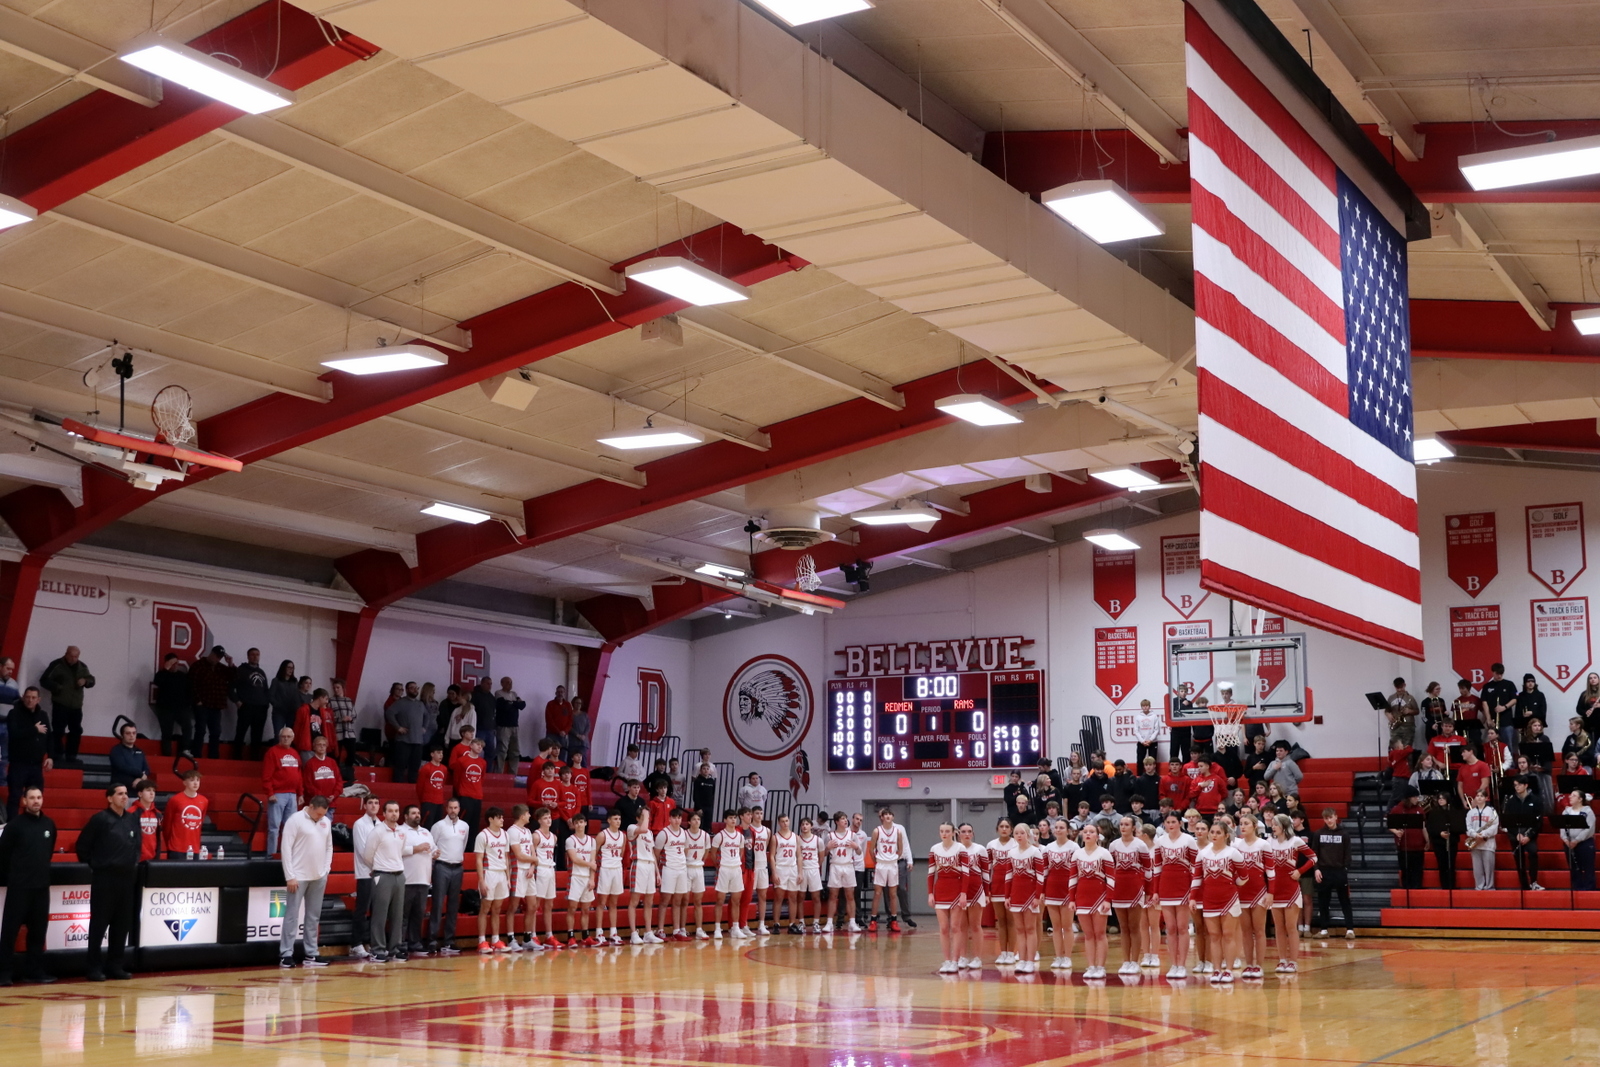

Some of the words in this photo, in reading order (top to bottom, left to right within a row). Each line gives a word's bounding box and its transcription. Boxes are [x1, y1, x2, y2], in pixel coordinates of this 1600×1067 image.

[1467, 576, 1480, 590] B
[1551, 570, 1565, 584] B
[38, 580, 96, 598] ELLEVUE
[1109, 600, 1121, 613] B
[1181, 595, 1192, 608] B
[846, 638, 1022, 678] BELLEVUE
[1471, 669, 1484, 684] B
[1556, 665, 1570, 679] B
[917, 676, 957, 698] 8:00
[1111, 684, 1123, 698] B
[1182, 681, 1195, 695] B
[836, 692, 844, 704] 0
[847, 692, 854, 704] 0
[864, 691, 871, 703] 0
[637, 667, 668, 745] D
[836, 705, 844, 717] 2
[847, 705, 854, 716] 0
[864, 704, 871, 716] 0
[885, 702, 913, 712] REDMEN
[954, 700, 974, 710] RAMS
[847, 718, 854, 730] 0
[864, 717, 871, 729] 0
[896, 714, 907, 734] 0
[931, 716, 936, 730] 1
[973, 711, 984, 732] 0
[833, 731, 844, 743] 10
[847, 731, 854, 743] 0
[864, 730, 871, 742] 0
[994, 726, 1008, 738] 25
[1012, 725, 1020, 738] 0
[1031, 725, 1039, 737] 0
[833, 745, 844, 756] 12
[847, 744, 854, 756] 0
[864, 744, 871, 756] 0
[975, 741, 984, 758] 0
[994, 740, 1009, 752] 31
[1012, 739, 1020, 751] 0
[1031, 738, 1039, 751] 0
[884, 744, 893, 760] 0
[847, 758, 854, 769] 0
[1012, 753, 1020, 765] 0
[993, 774, 1005, 784] EXIT
[755, 842, 764, 851] 30
[883, 845, 892, 853] 34
[1161, 846, 1186, 860] REDMEN
[498, 849, 502, 859] 2
[692, 851, 697, 860] 4
[783, 849, 792, 858] 20
[1203, 857, 1229, 871] REDMEN
[62, 891, 90, 900] LAUG
[150, 891, 212, 905] CROGHAN
[150, 907, 188, 916] COLONIAL
[191, 906, 211, 914] BANK
